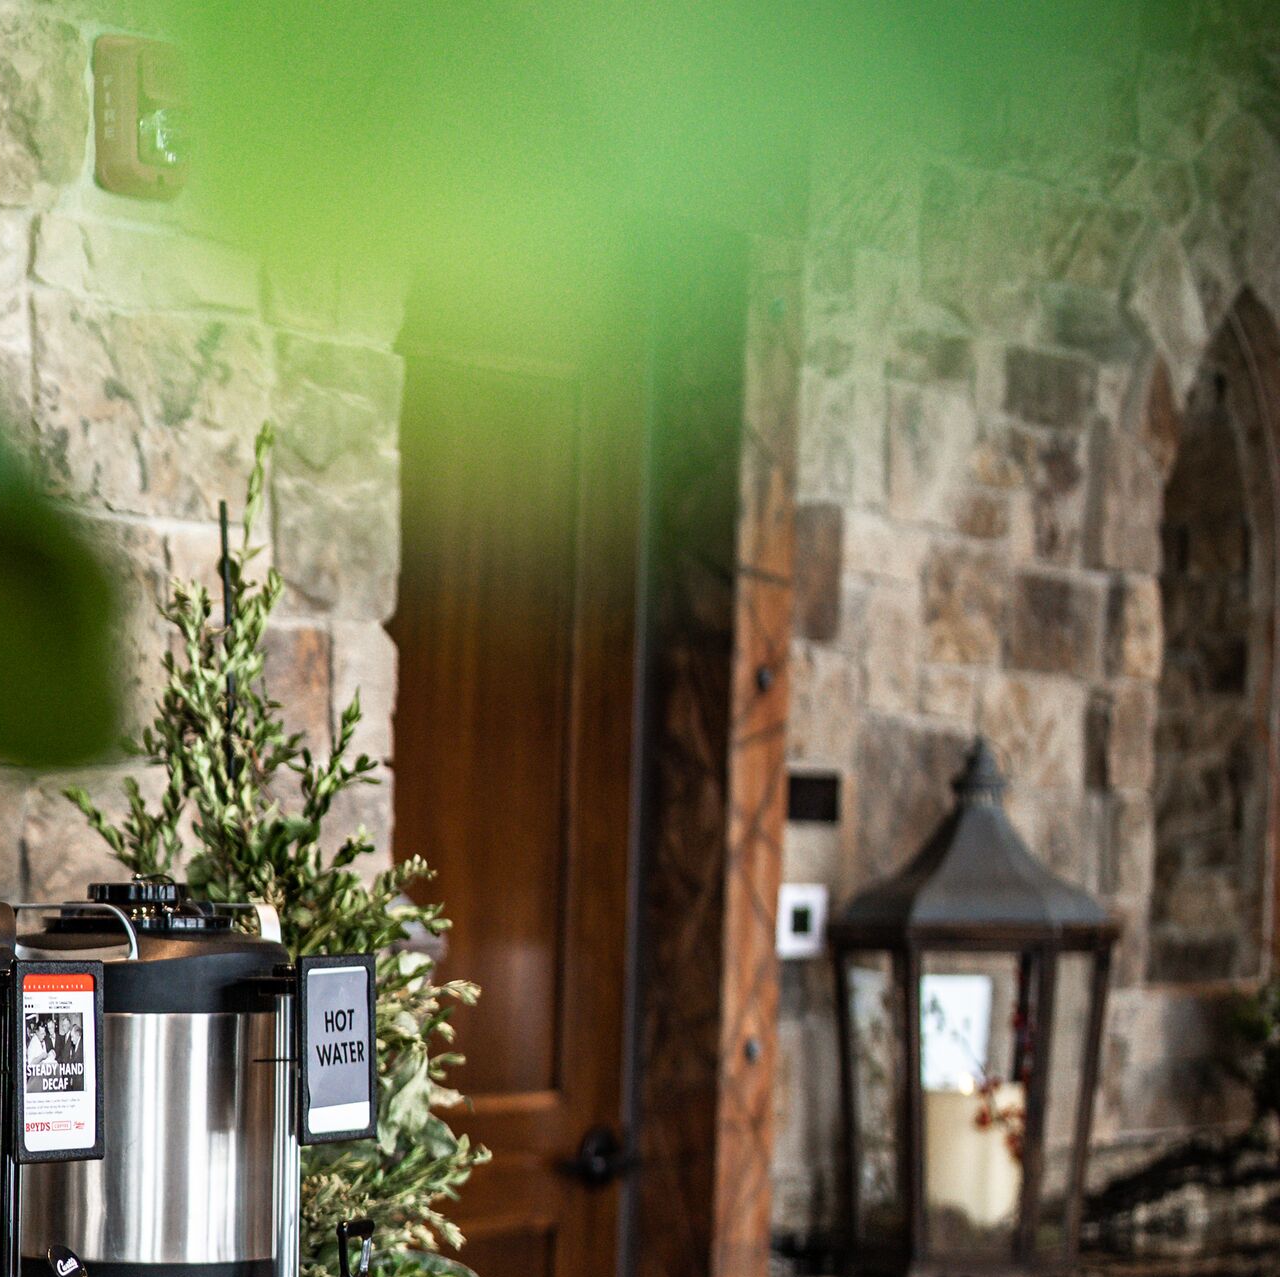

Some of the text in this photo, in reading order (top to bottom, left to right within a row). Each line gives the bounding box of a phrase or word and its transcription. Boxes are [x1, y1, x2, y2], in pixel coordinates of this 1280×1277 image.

[324, 1009, 355, 1033] HOT
[316, 1041, 365, 1067] WATER
[26, 1062, 84, 1077] STEADY HAND
[42, 1077, 69, 1091] DECAF
[56, 1256, 79, 1277] Curtis
